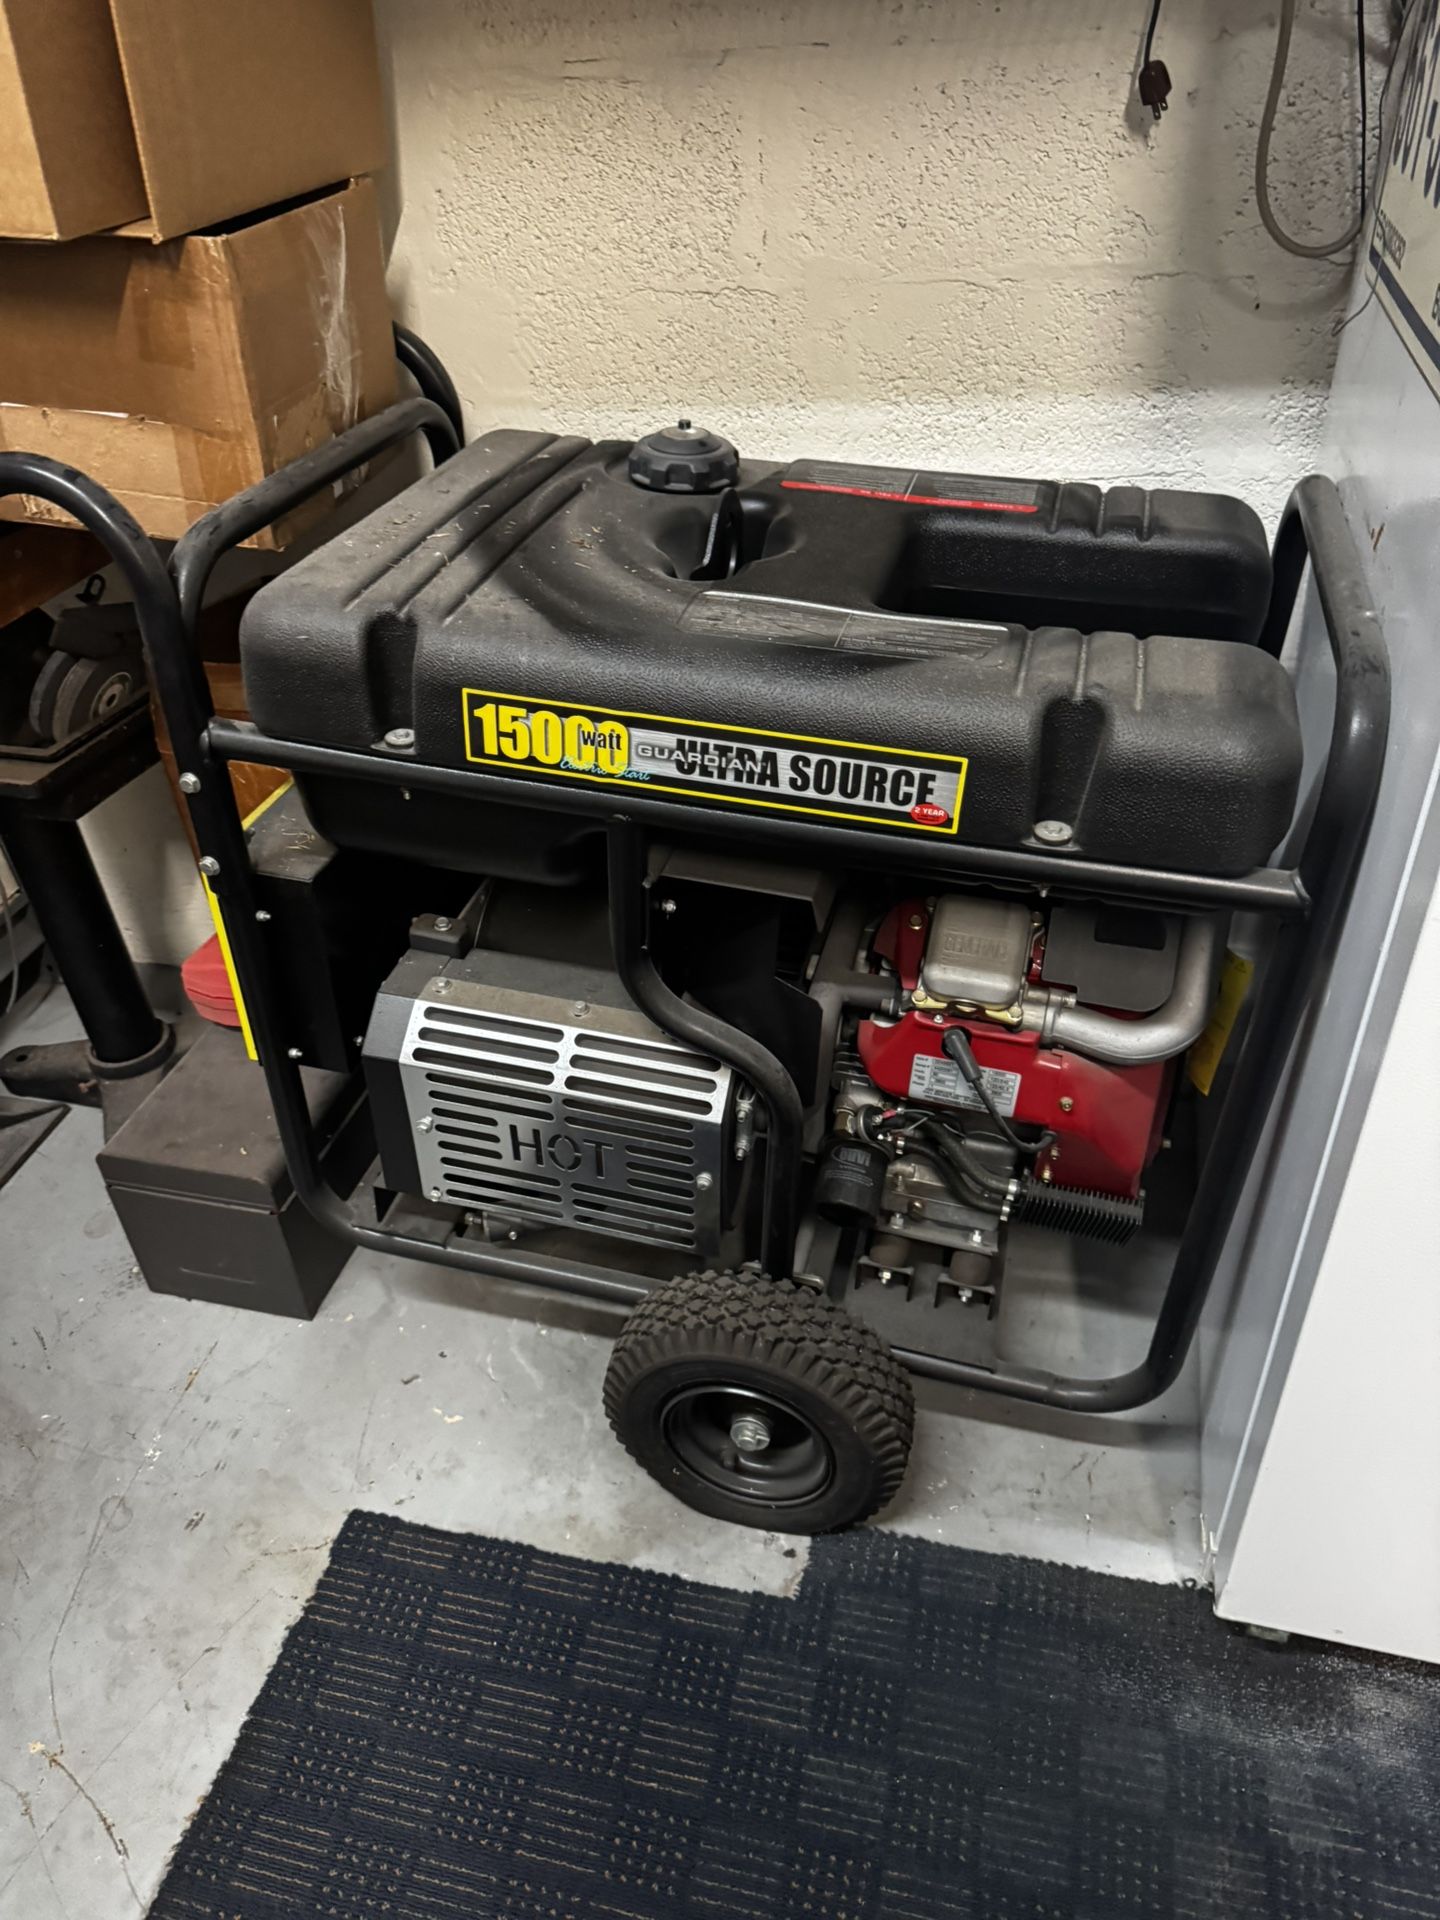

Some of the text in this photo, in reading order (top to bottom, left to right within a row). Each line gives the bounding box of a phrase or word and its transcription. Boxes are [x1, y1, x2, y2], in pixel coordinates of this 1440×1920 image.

[473, 703, 630, 776] 15000
[581, 728, 622, 751] watt
[636, 745, 763, 773] GUARDIAN
[675, 737, 937, 807] ULTRA SOURCE
[913, 806, 945, 817] 2 YEAR
[508, 1123, 615, 1180] HOT
